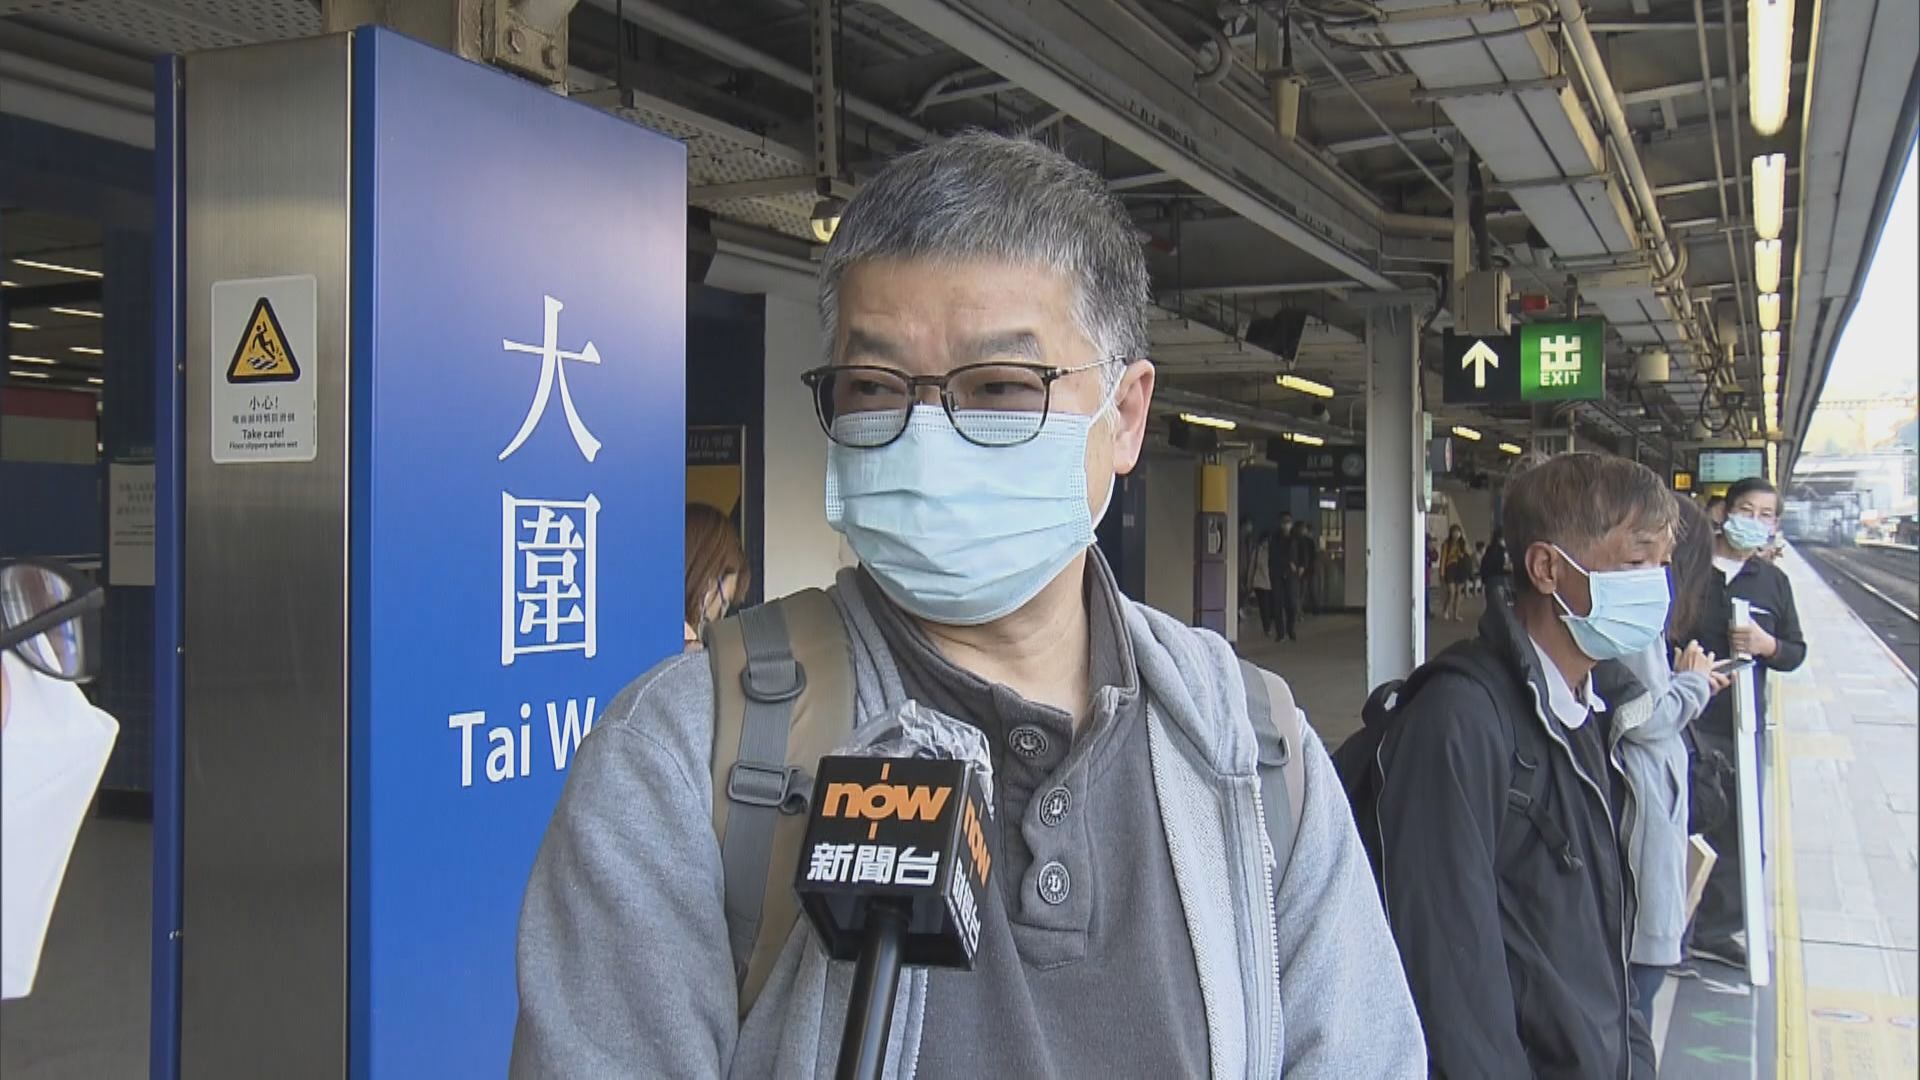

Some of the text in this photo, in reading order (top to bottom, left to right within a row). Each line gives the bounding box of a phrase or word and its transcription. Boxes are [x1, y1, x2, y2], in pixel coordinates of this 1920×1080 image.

[1540, 334, 1582, 370] 出
[1540, 370, 1582, 387] EXIT
[242, 427, 284, 440] Take care!
[269, 440, 286, 449] when
[498, 294, 602, 666] 大圍
[448, 696, 600, 788] Tai W
[822, 775, 953, 829] now
[806, 842, 940, 887] 新聞台
